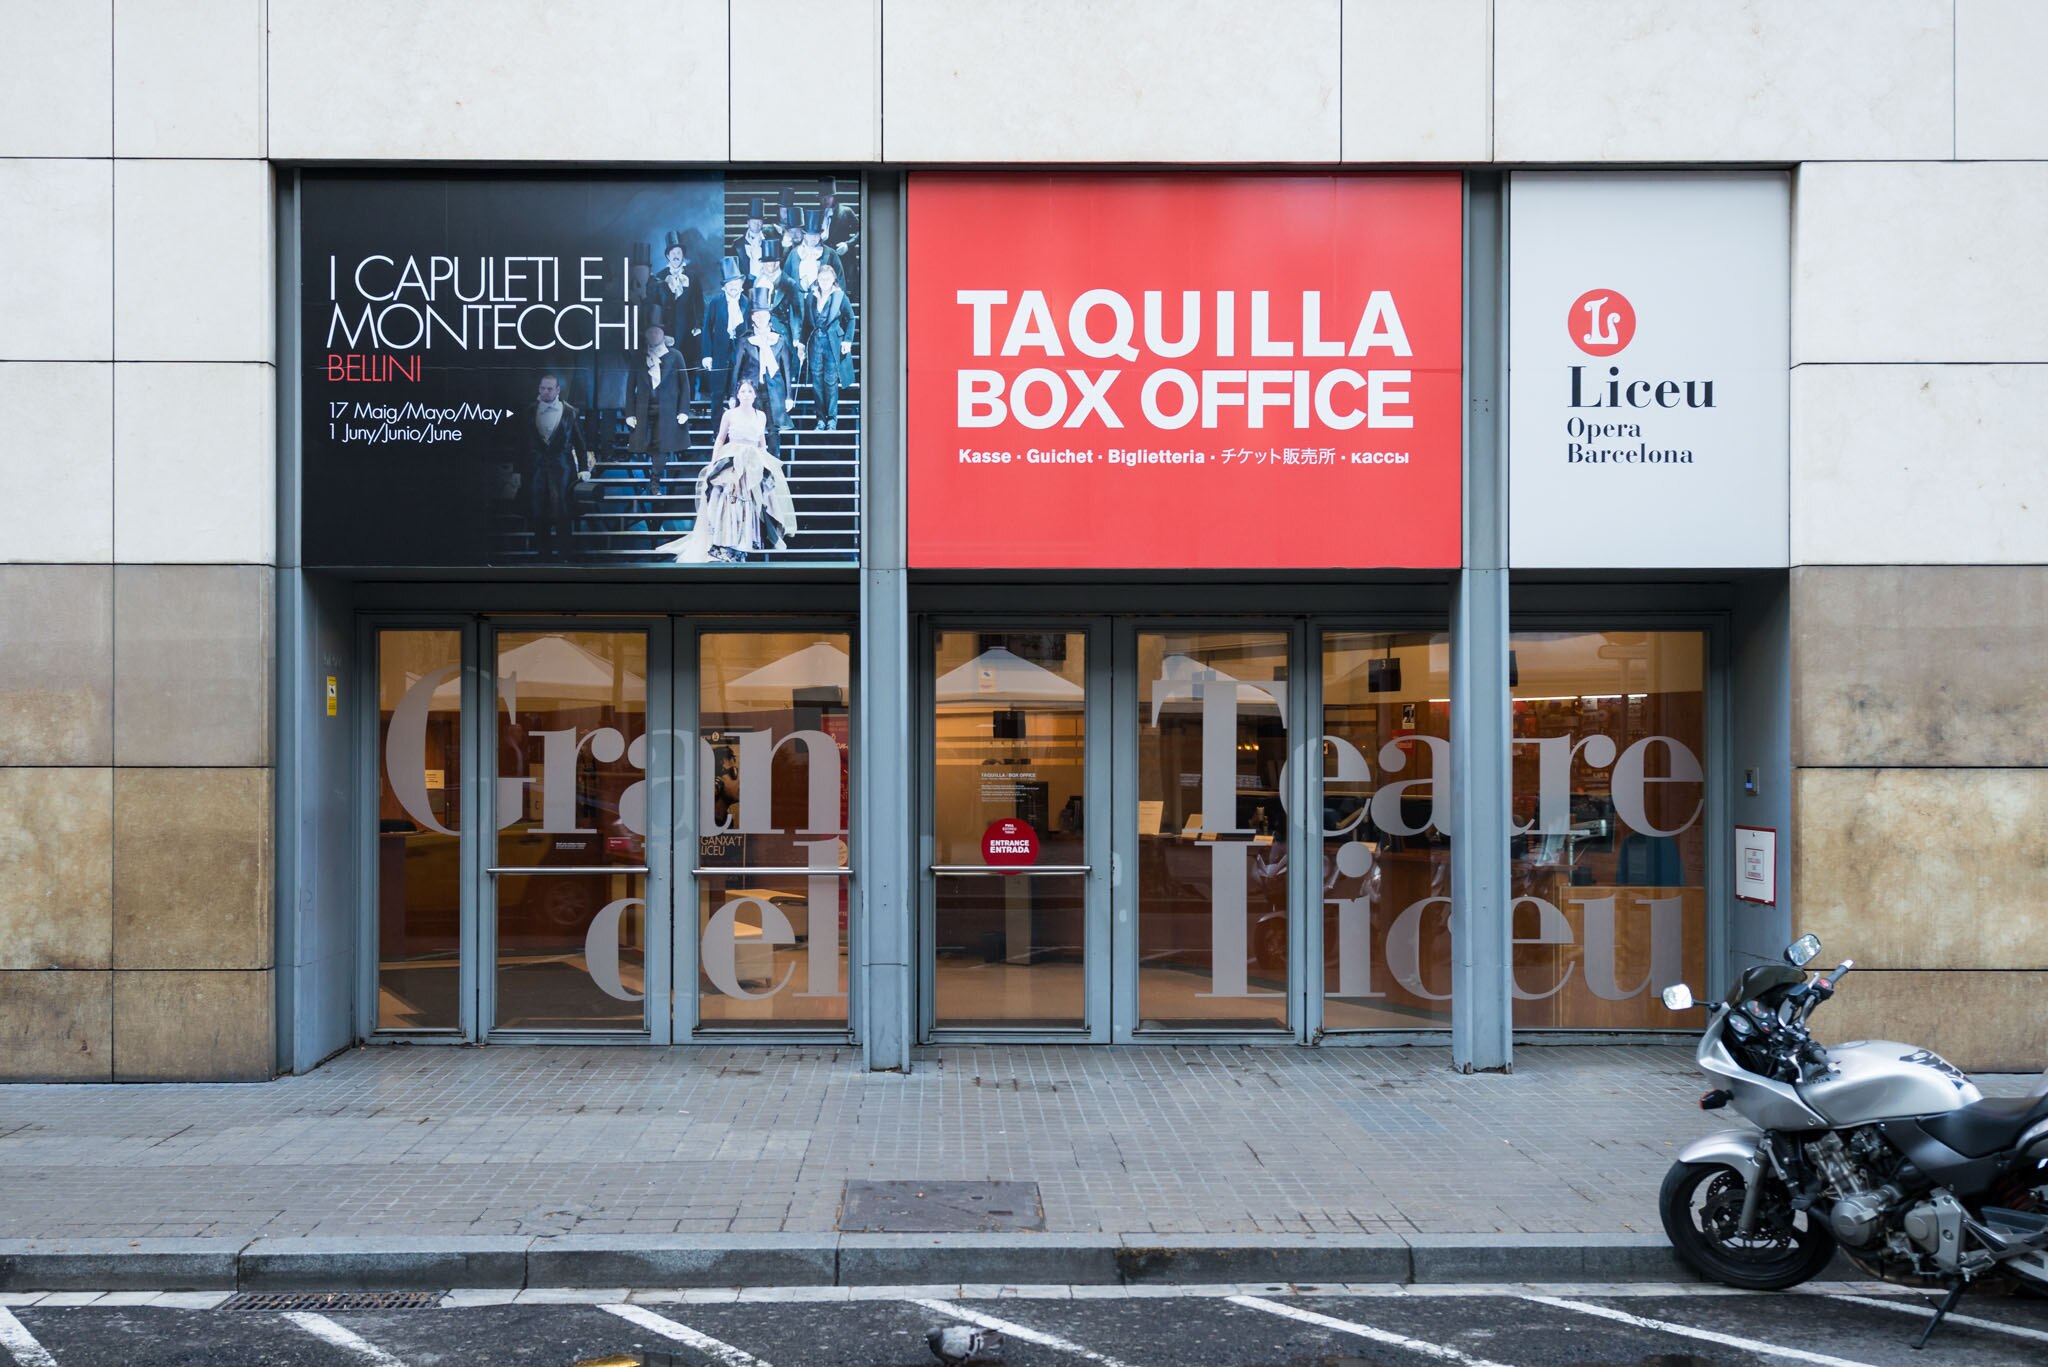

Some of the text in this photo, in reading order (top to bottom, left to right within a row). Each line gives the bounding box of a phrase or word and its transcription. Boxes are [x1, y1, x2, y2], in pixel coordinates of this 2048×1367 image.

[330, 254, 629, 302] I CAPULETI E I
[326, 303, 639, 351] MONTECCHI
[957, 289, 1414, 362] TAQUILLA
[327, 354, 421, 383] BELLINI
[957, 368, 1414, 430] BOX OFFICE
[1567, 365, 1717, 409] Liceu
[329, 401, 502, 425] 17 Maig/Mayo/May
[329, 422, 463, 446] 1 Juny/Junio/June
[1567, 416, 1642, 445] Opera
[958, 448, 1205, 467] Kasse Guichet Biglietteria
[1220, 447, 1336, 465] チケット販売所
[1567, 443, 1694, 464] Barcelona
[386, 665, 848, 837] Gran
[1152, 680, 1705, 838] Teare
[701, 845, 725, 855] LICEU
[989, 846, 1030, 854] ENTRADA
